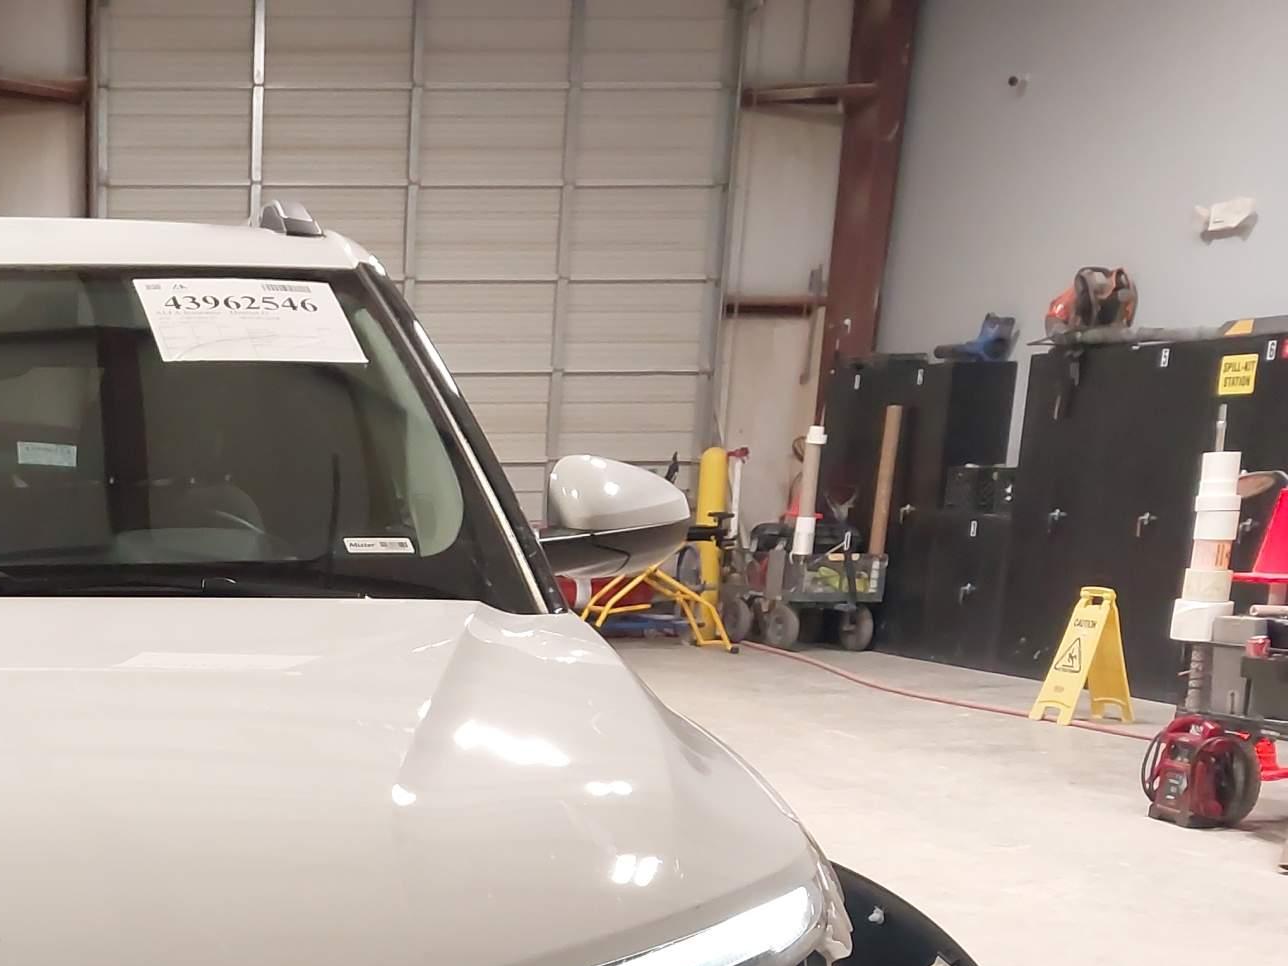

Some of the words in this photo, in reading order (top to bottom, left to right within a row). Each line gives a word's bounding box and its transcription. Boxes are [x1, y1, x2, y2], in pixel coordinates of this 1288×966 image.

[163, 295, 318, 313] 43962546
[1223, 376, 1251, 388] STATION
[1073, 618, 1097, 629] CAUTION
